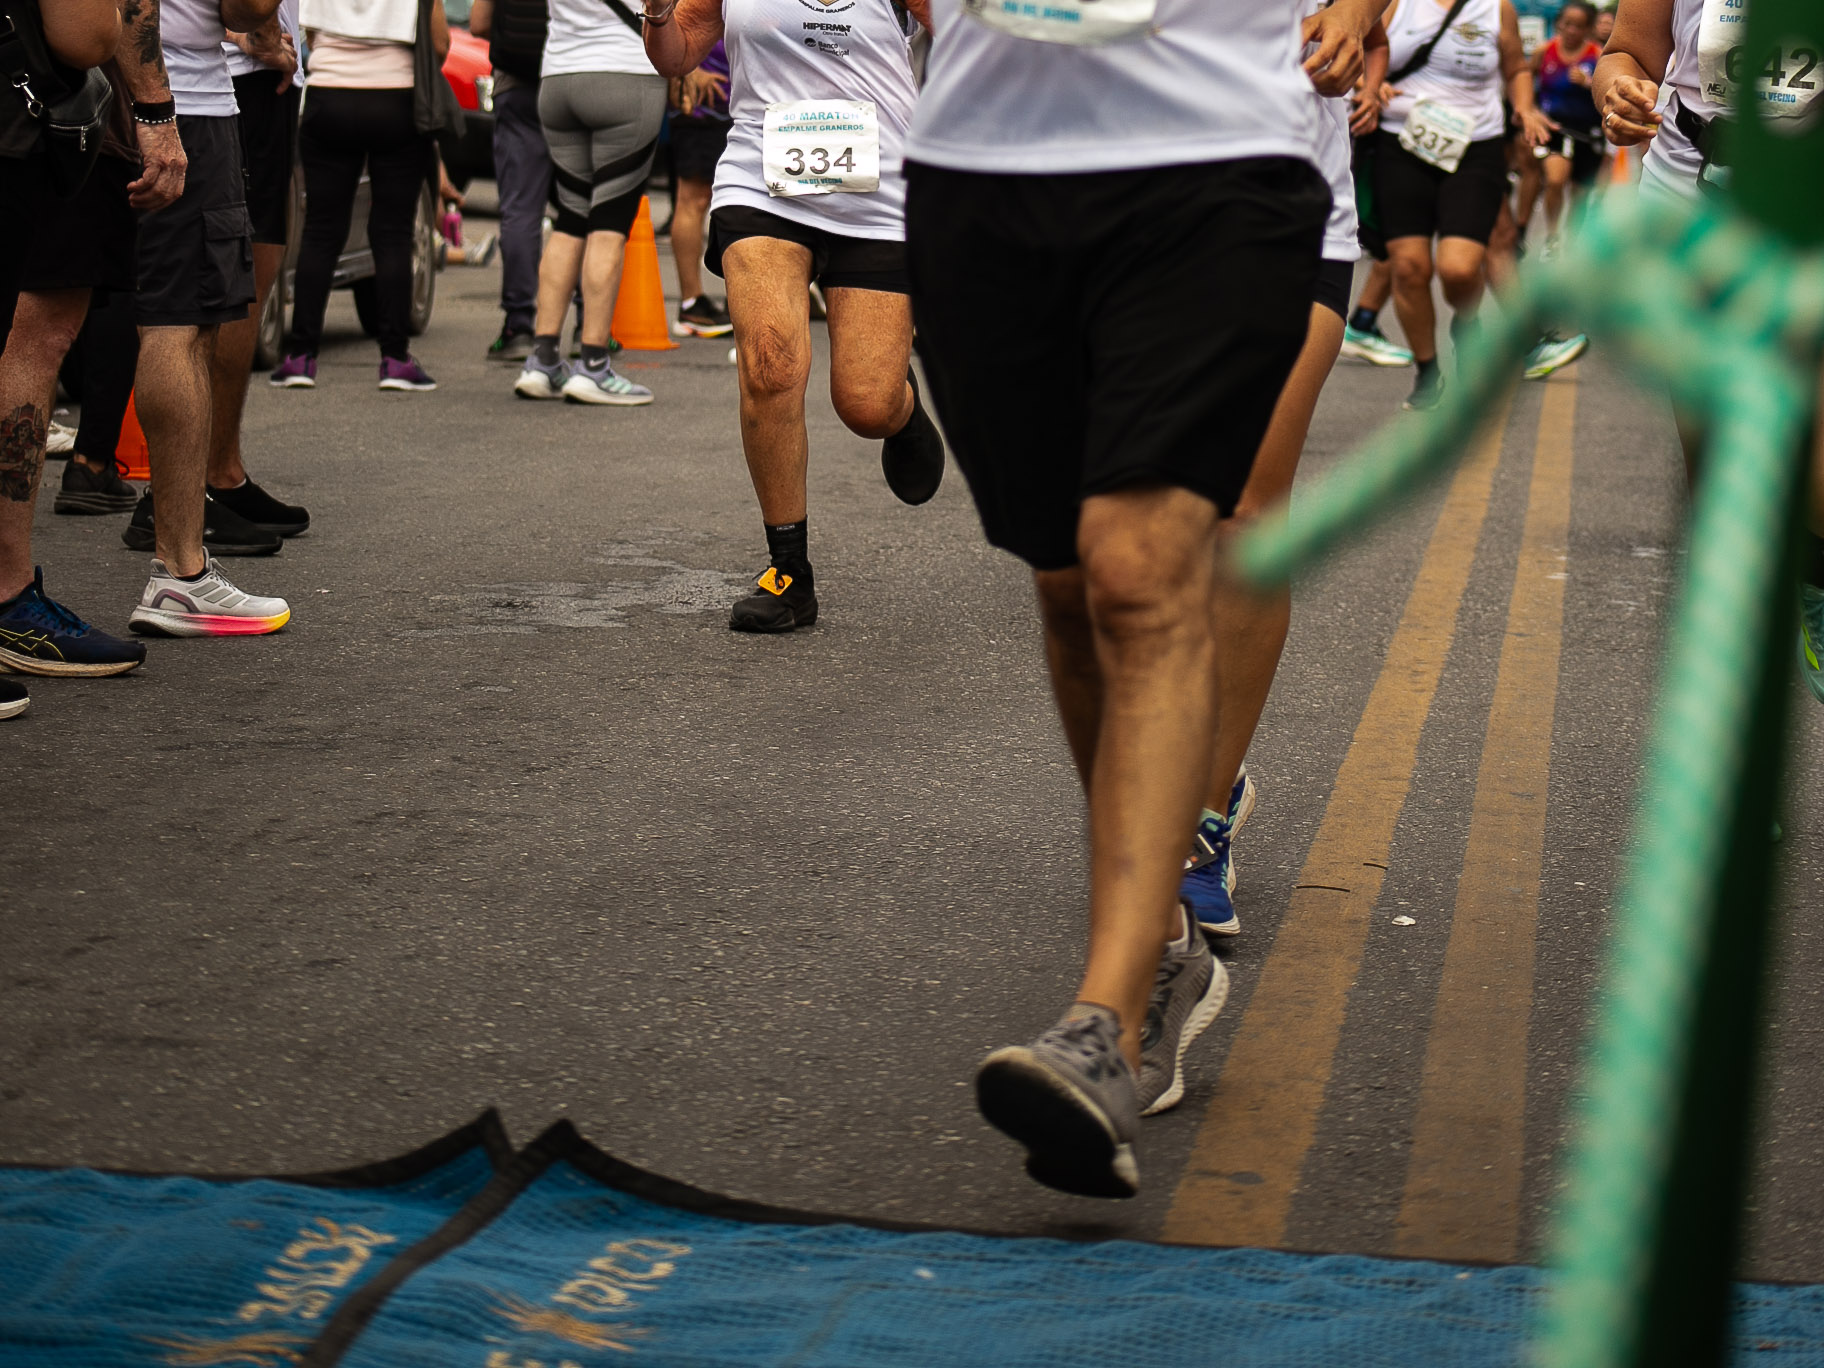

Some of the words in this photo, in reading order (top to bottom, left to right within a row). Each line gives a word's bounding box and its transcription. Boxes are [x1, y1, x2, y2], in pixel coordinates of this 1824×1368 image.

[819, 124, 864, 132] GRANEROS
[1412, 124, 1454, 154] 237
[785, 147, 856, 176] 334
